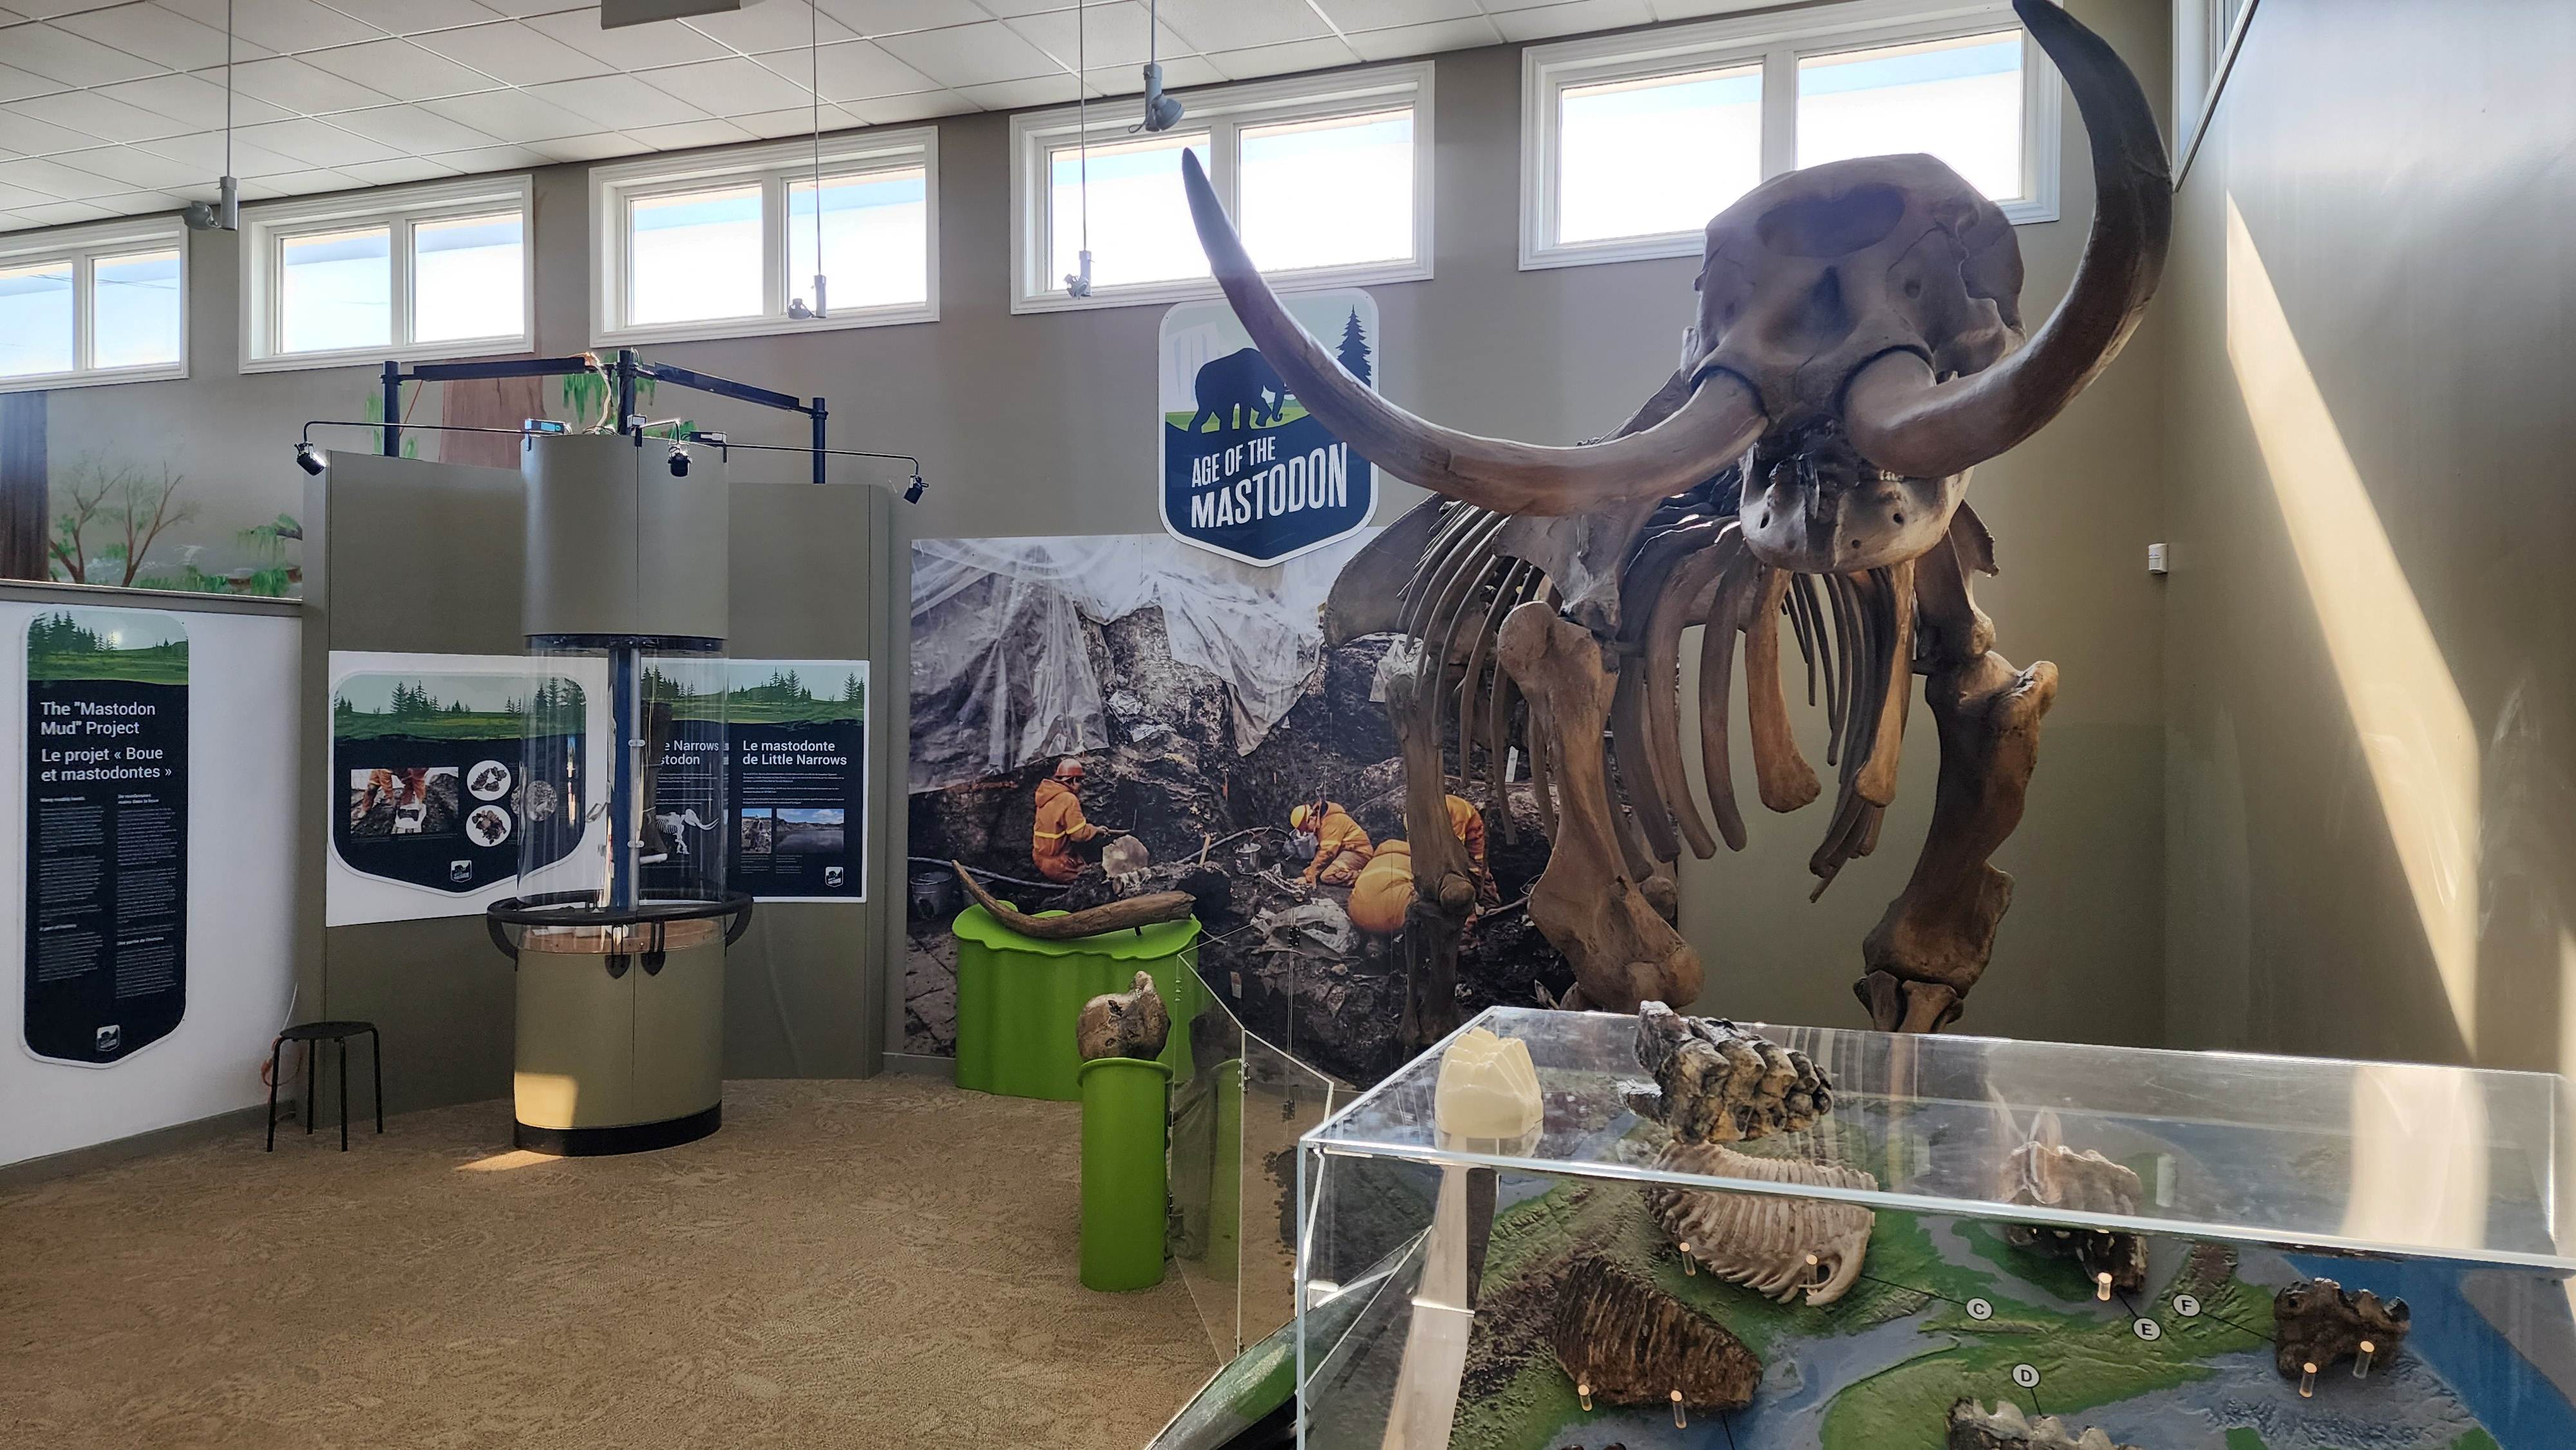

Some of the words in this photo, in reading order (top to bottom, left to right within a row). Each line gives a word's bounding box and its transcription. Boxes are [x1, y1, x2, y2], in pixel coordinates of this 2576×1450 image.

[1191, 453, 1220, 487] AGE
[1225, 444, 1244, 476] OF
[1248, 436, 1276, 466] THE
[1191, 442, 1347, 528] MASTODON
[40, 701, 71, 715] The
[74, 701, 156, 715] "Mastodon
[41, 720, 82, 735] Mud"
[86, 720, 140, 738] Project
[674, 740, 719, 751] Narrows
[743, 740, 758, 751] Le
[761, 740, 835, 751] mastodonte
[41, 748, 61, 762] Le
[64, 747, 109, 765] projet
[126, 747, 164, 760] Boue
[660, 753, 700, 765] stodon
[743, 753, 758, 765] de
[762, 753, 793, 765] Little
[797, 753, 848, 765] Narrows
[41, 769, 57, 782] et
[61, 765, 160, 781] mastodontes
[1973, 1303, 1985, 1315] C
[2181, 1299, 2192, 1312] F
[2141, 1323, 2153, 1336] E
[2020, 1369, 2032, 1382] D
